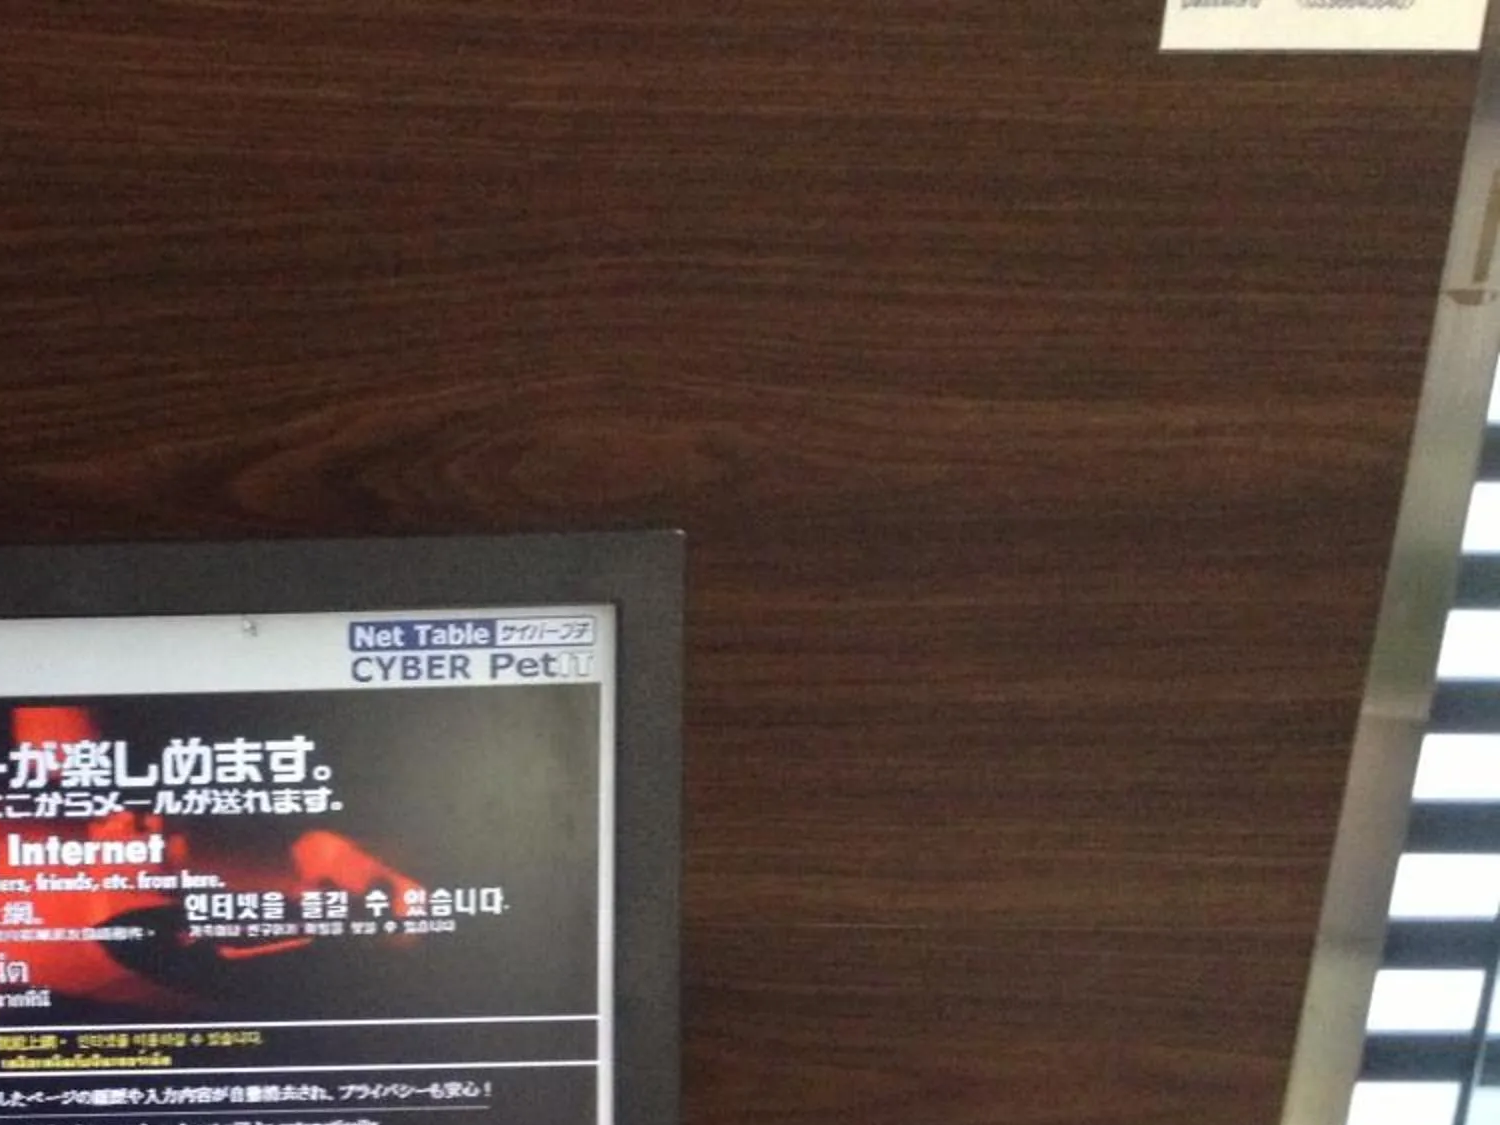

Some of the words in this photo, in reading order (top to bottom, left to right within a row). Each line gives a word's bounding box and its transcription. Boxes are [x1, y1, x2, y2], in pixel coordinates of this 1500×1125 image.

[354, 624, 405, 648] Net
[413, 622, 491, 647] Table
[351, 654, 471, 683] CYBER
[7, 833, 166, 867] Internet
[184, 892, 286, 922] 인터넷을
[300, 890, 349, 920] 즐길
[364, 889, 391, 918] 수
